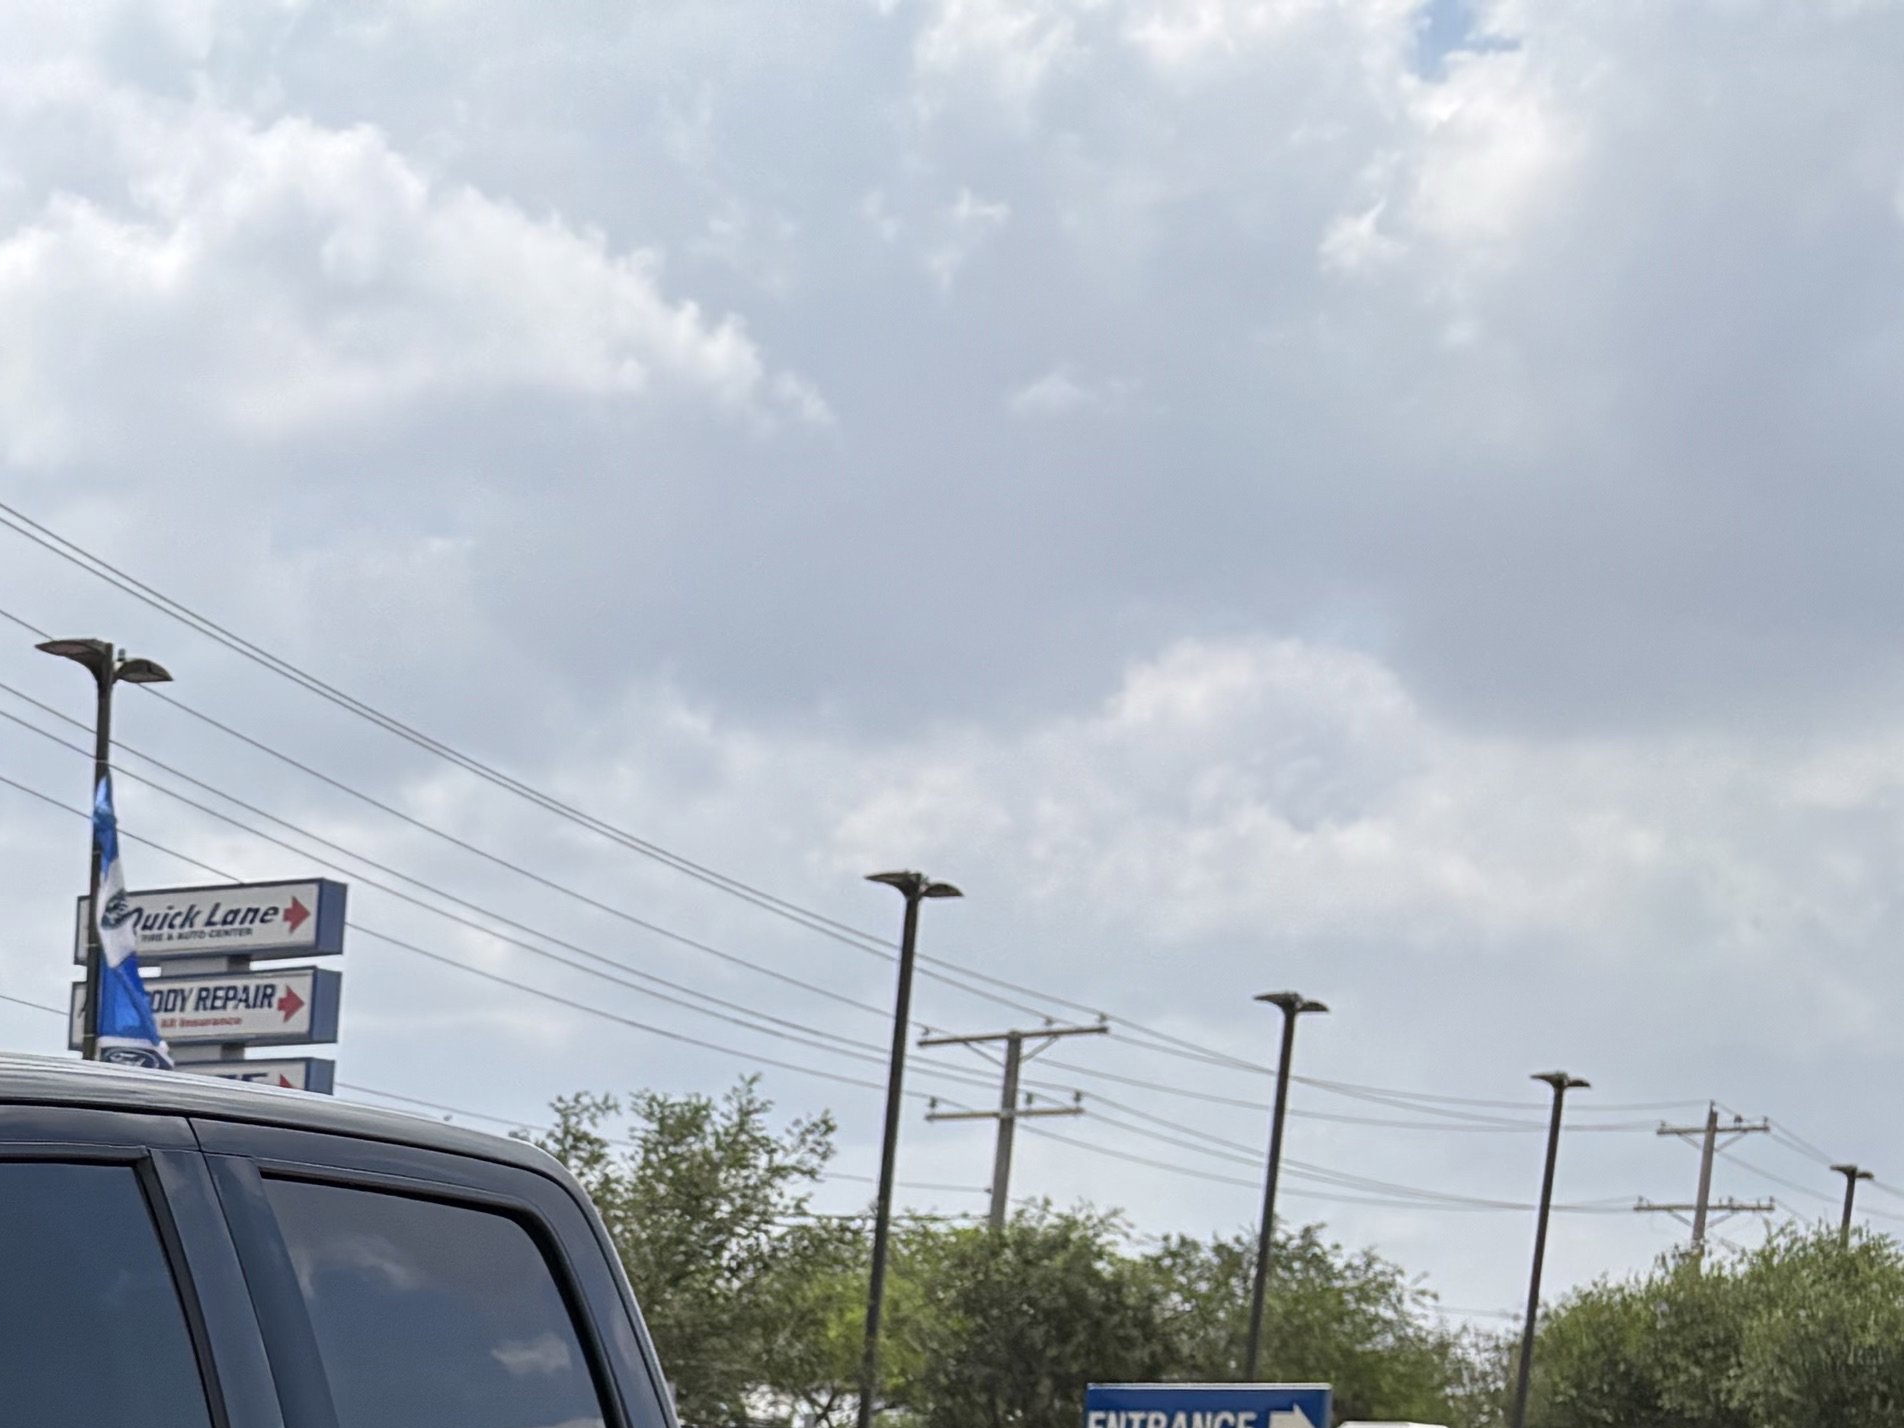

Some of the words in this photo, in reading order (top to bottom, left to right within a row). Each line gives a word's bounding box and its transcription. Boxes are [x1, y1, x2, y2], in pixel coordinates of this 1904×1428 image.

[204, 902, 279, 928] Lane
[177, 930, 206, 940] AUTO
[208, 927, 253, 938] CENTER
[151, 987, 193, 1013] ODY
[194, 983, 276, 1011] REPAIR
